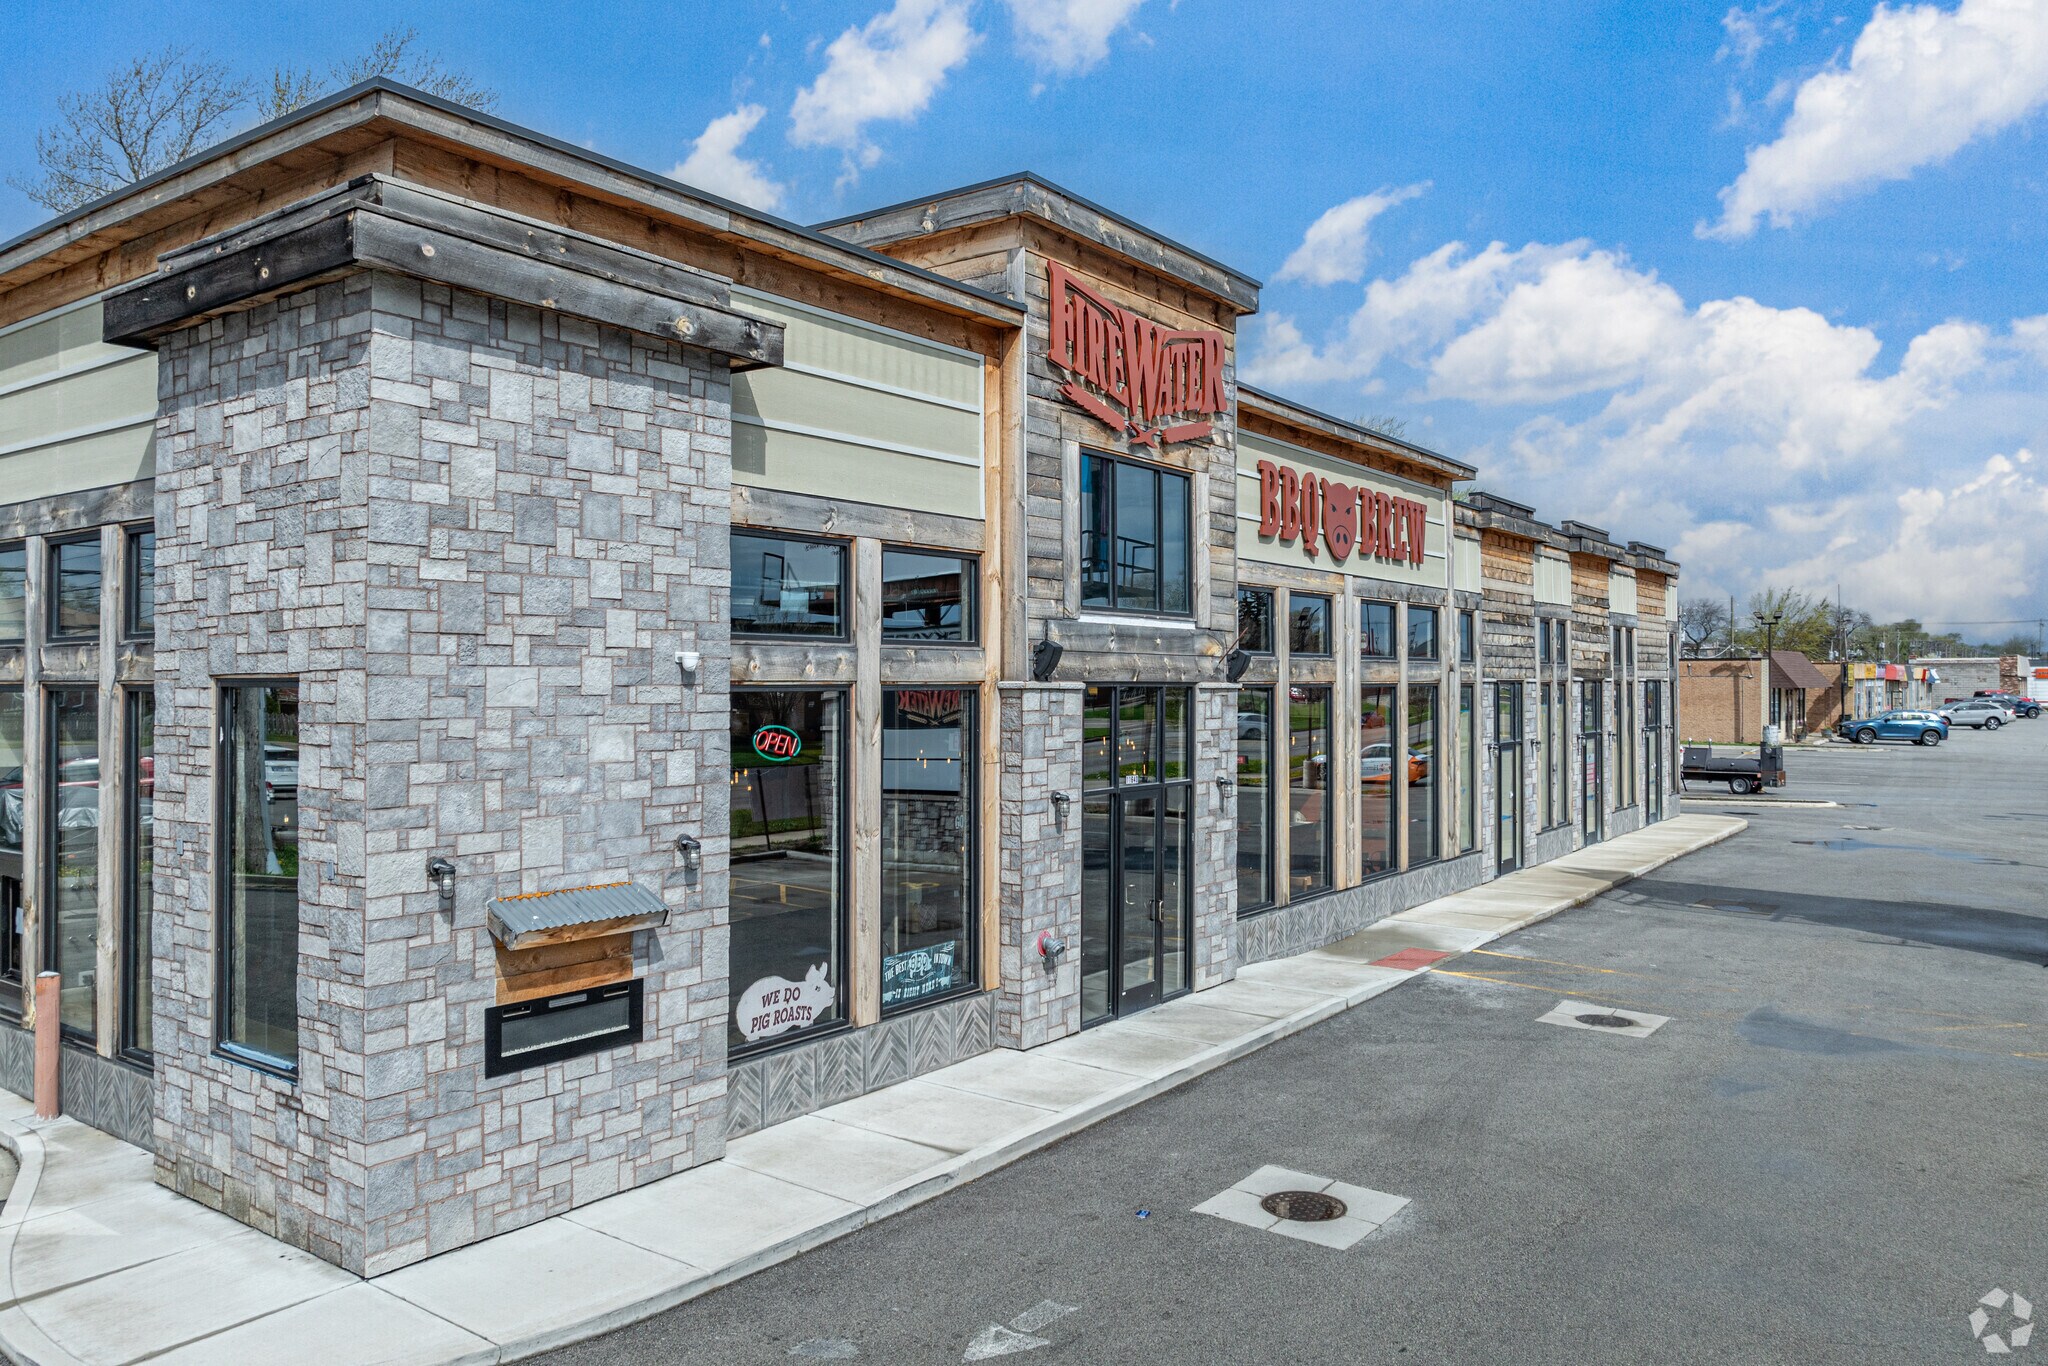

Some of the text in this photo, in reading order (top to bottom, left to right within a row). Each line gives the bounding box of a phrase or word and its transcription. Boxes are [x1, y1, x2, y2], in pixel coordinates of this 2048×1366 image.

[1258, 460, 1428, 564] BBQ BREW
[756, 731, 798, 757] OPEN
[885, 968, 894, 982] THE
[895, 961, 907, 975] BEST
[762, 987, 800, 1008] WE DO
[750, 1006, 812, 1034] PIG ROASTS
